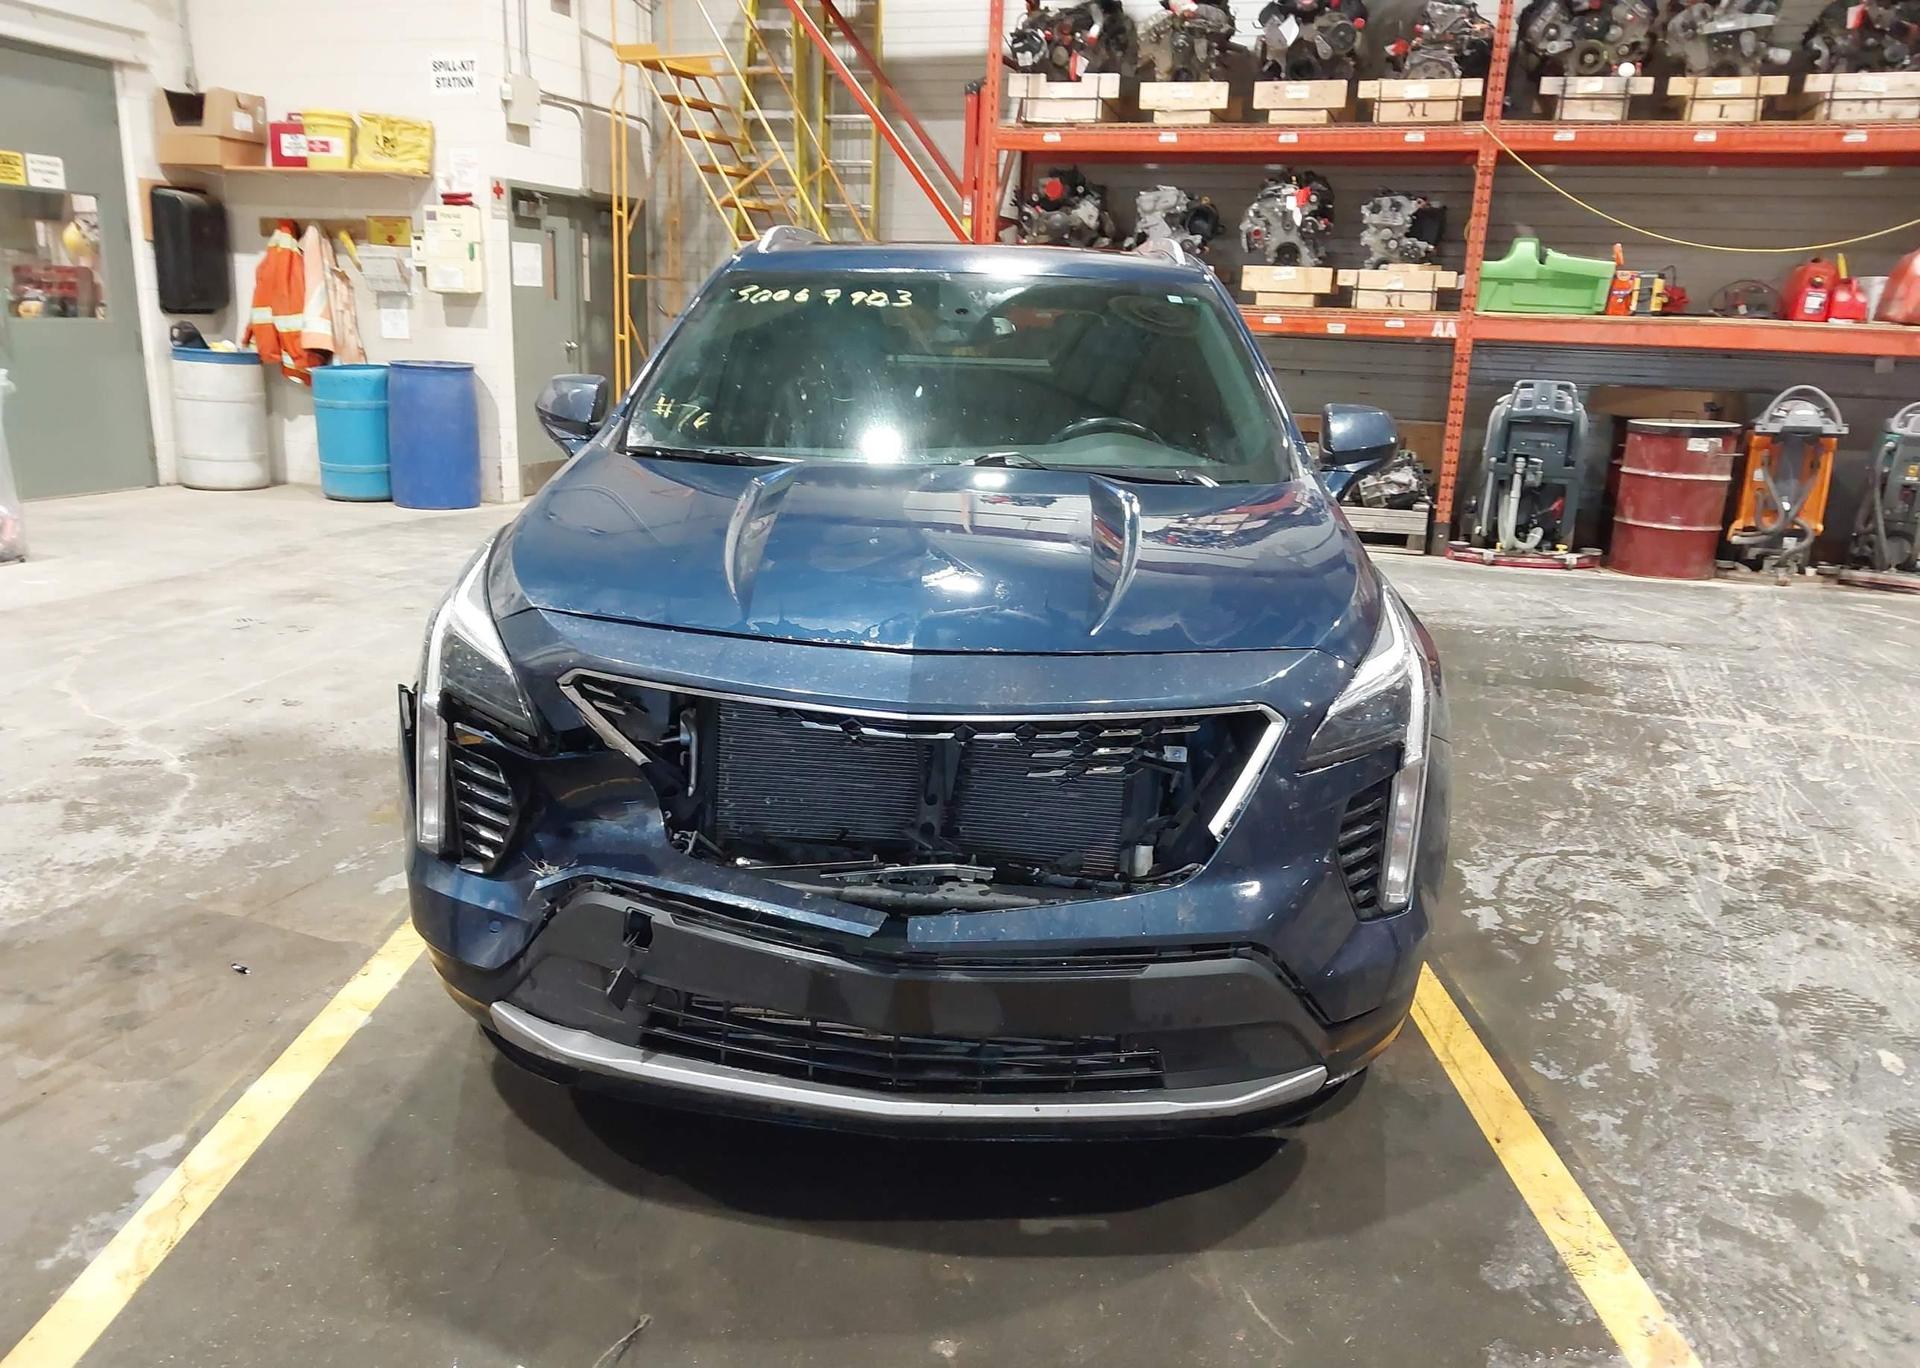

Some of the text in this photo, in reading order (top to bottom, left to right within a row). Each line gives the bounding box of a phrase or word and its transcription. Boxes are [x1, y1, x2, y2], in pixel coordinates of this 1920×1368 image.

[432, 60, 474, 72] SPILL-KIT
[435, 76, 474, 88] STATION
[1431, 320, 1457, 337] AA
